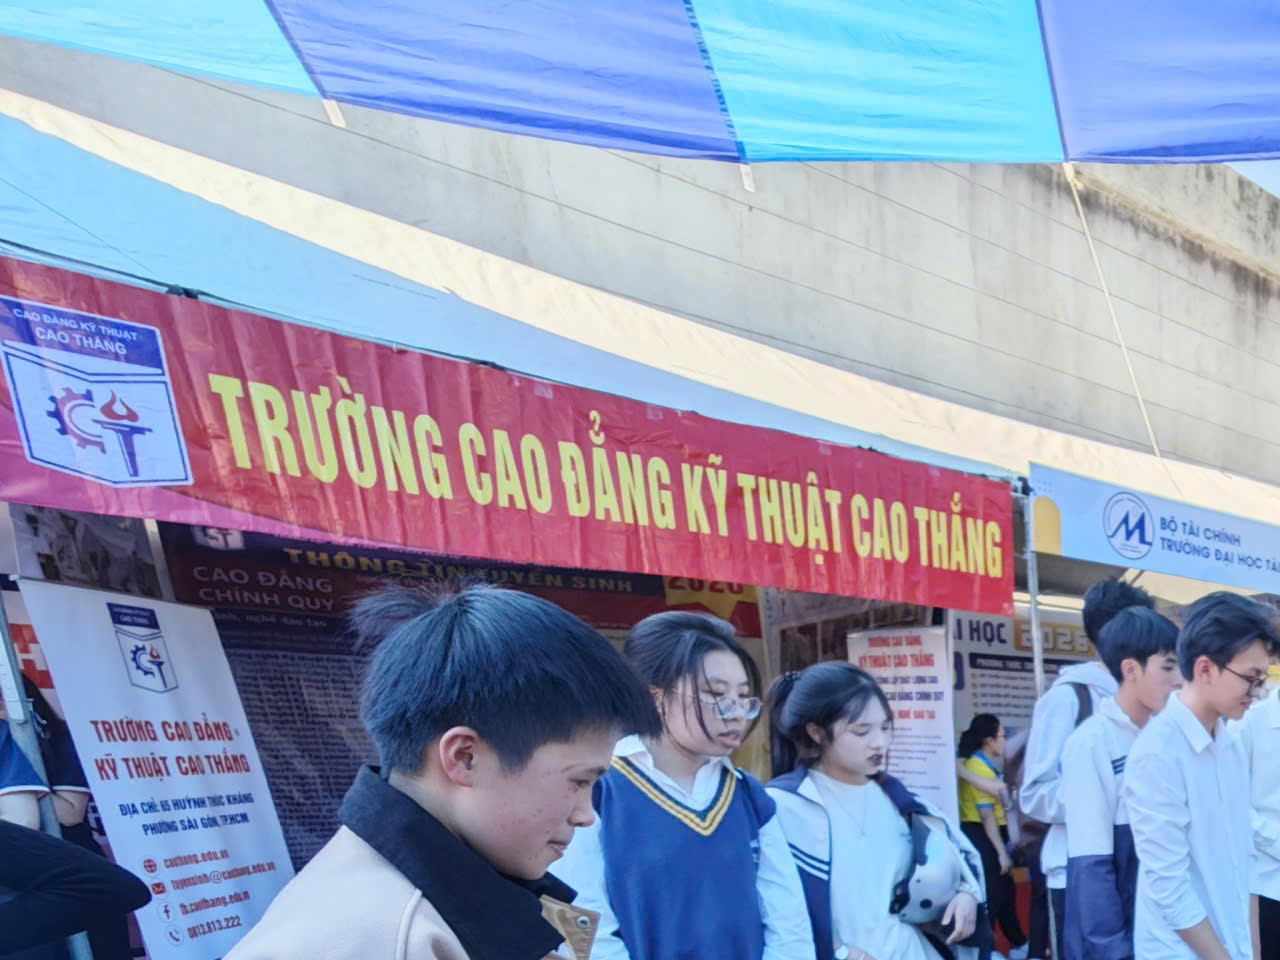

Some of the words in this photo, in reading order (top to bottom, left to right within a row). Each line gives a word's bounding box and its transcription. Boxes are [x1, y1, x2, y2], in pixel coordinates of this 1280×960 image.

[13, 308, 41, 322] CAO
[35, 326, 69, 344] CAO
[208, 373, 454, 501] TRƯỜNG
[459, 422, 553, 515] CAO
[558, 410, 675, 530] ĐẲNG
[681, 453, 728, 538] KỸ
[737, 471, 842, 565] THUẬT
[851, 493, 908, 564] CAO
[914, 490, 1003, 578] THẮNG
[1160, 515, 1178, 536] BỘ
[1181, 520, 1200, 539] TÀI
[1203, 526, 1241, 548] CHÍNH
[1215, 549, 1235, 568] ĐẠI
[192, 566, 249, 585] CAO
[571, 574, 633, 594] SINH
[200, 586, 280, 606] CHÍNH
[288, 594, 335, 611] QUY
[969, 619, 1007, 648] HỌC
[90, 715, 158, 743] TRƯỜNG
[161, 720, 193, 742] CAO
[193, 711, 233, 742] ĐẲNG
[94, 752, 119, 781] KỸ
[121, 751, 171, 783] THUẬT
[175, 755, 206, 777] CAO
[206, 747, 251, 774] THẮNG
[119, 802, 140, 819] ĐỊA
